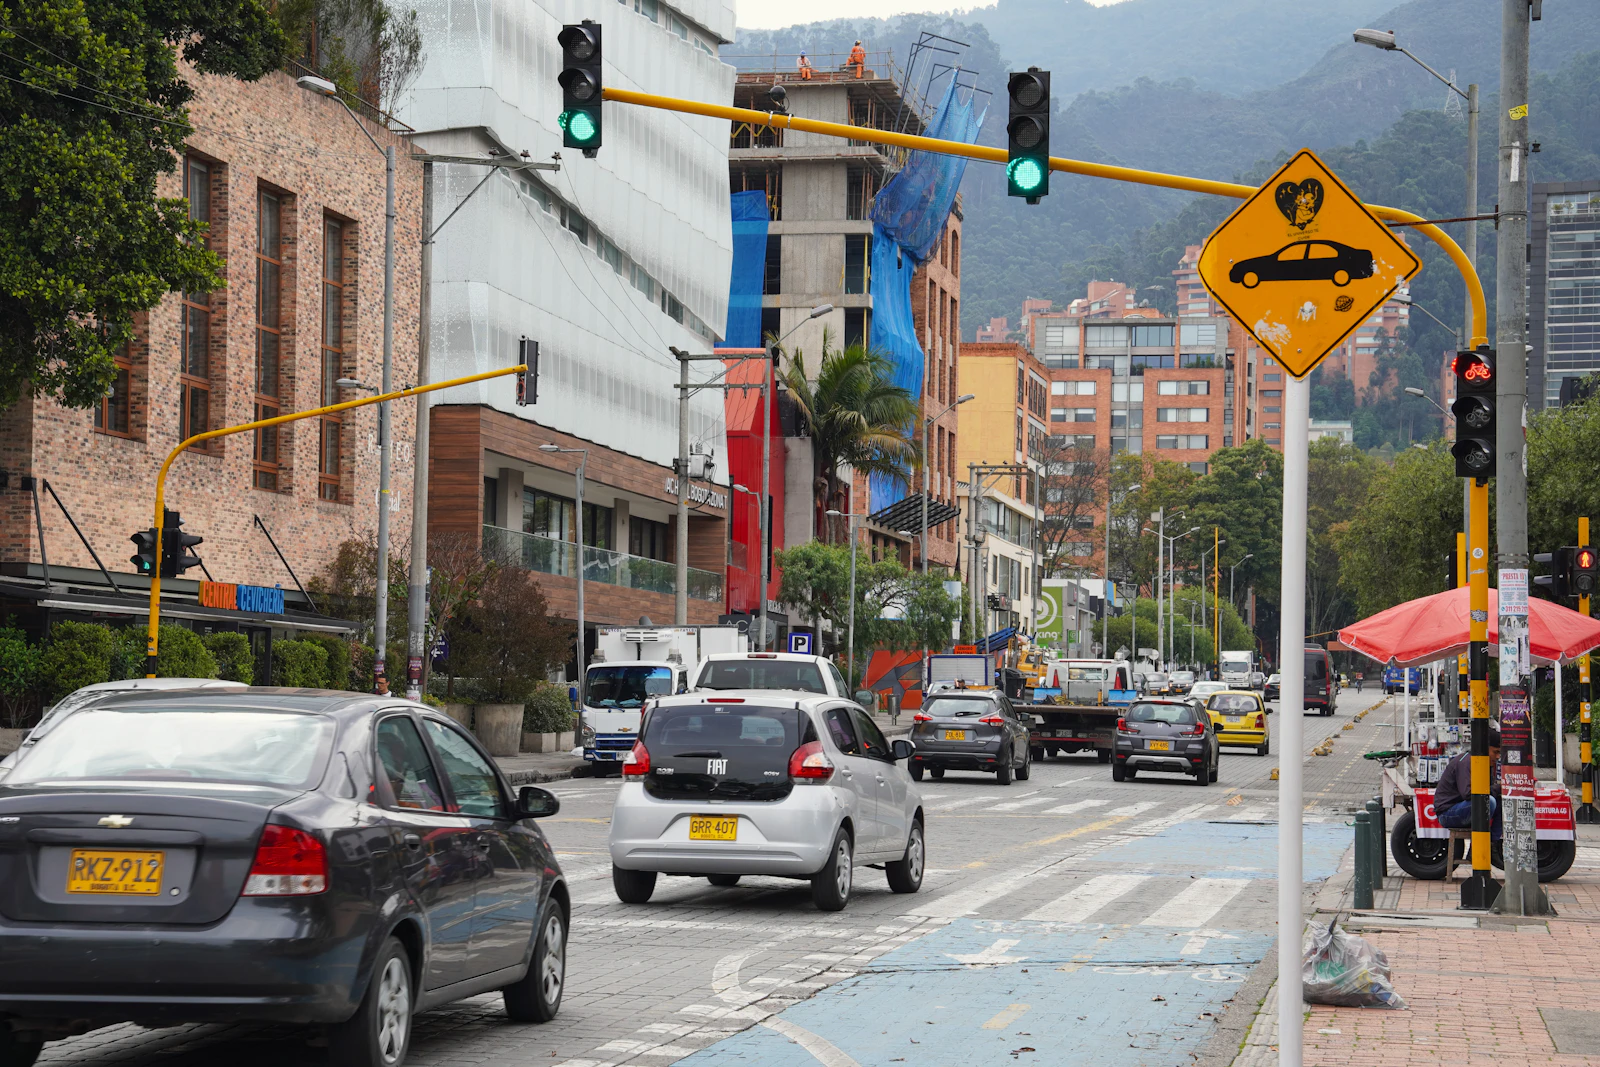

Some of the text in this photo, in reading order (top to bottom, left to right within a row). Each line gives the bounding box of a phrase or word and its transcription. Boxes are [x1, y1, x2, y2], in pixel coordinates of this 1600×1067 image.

[202, 581, 238, 610] CENTRAL
[794, 636, 806, 651] P
[706, 759, 728, 775] FIAT
